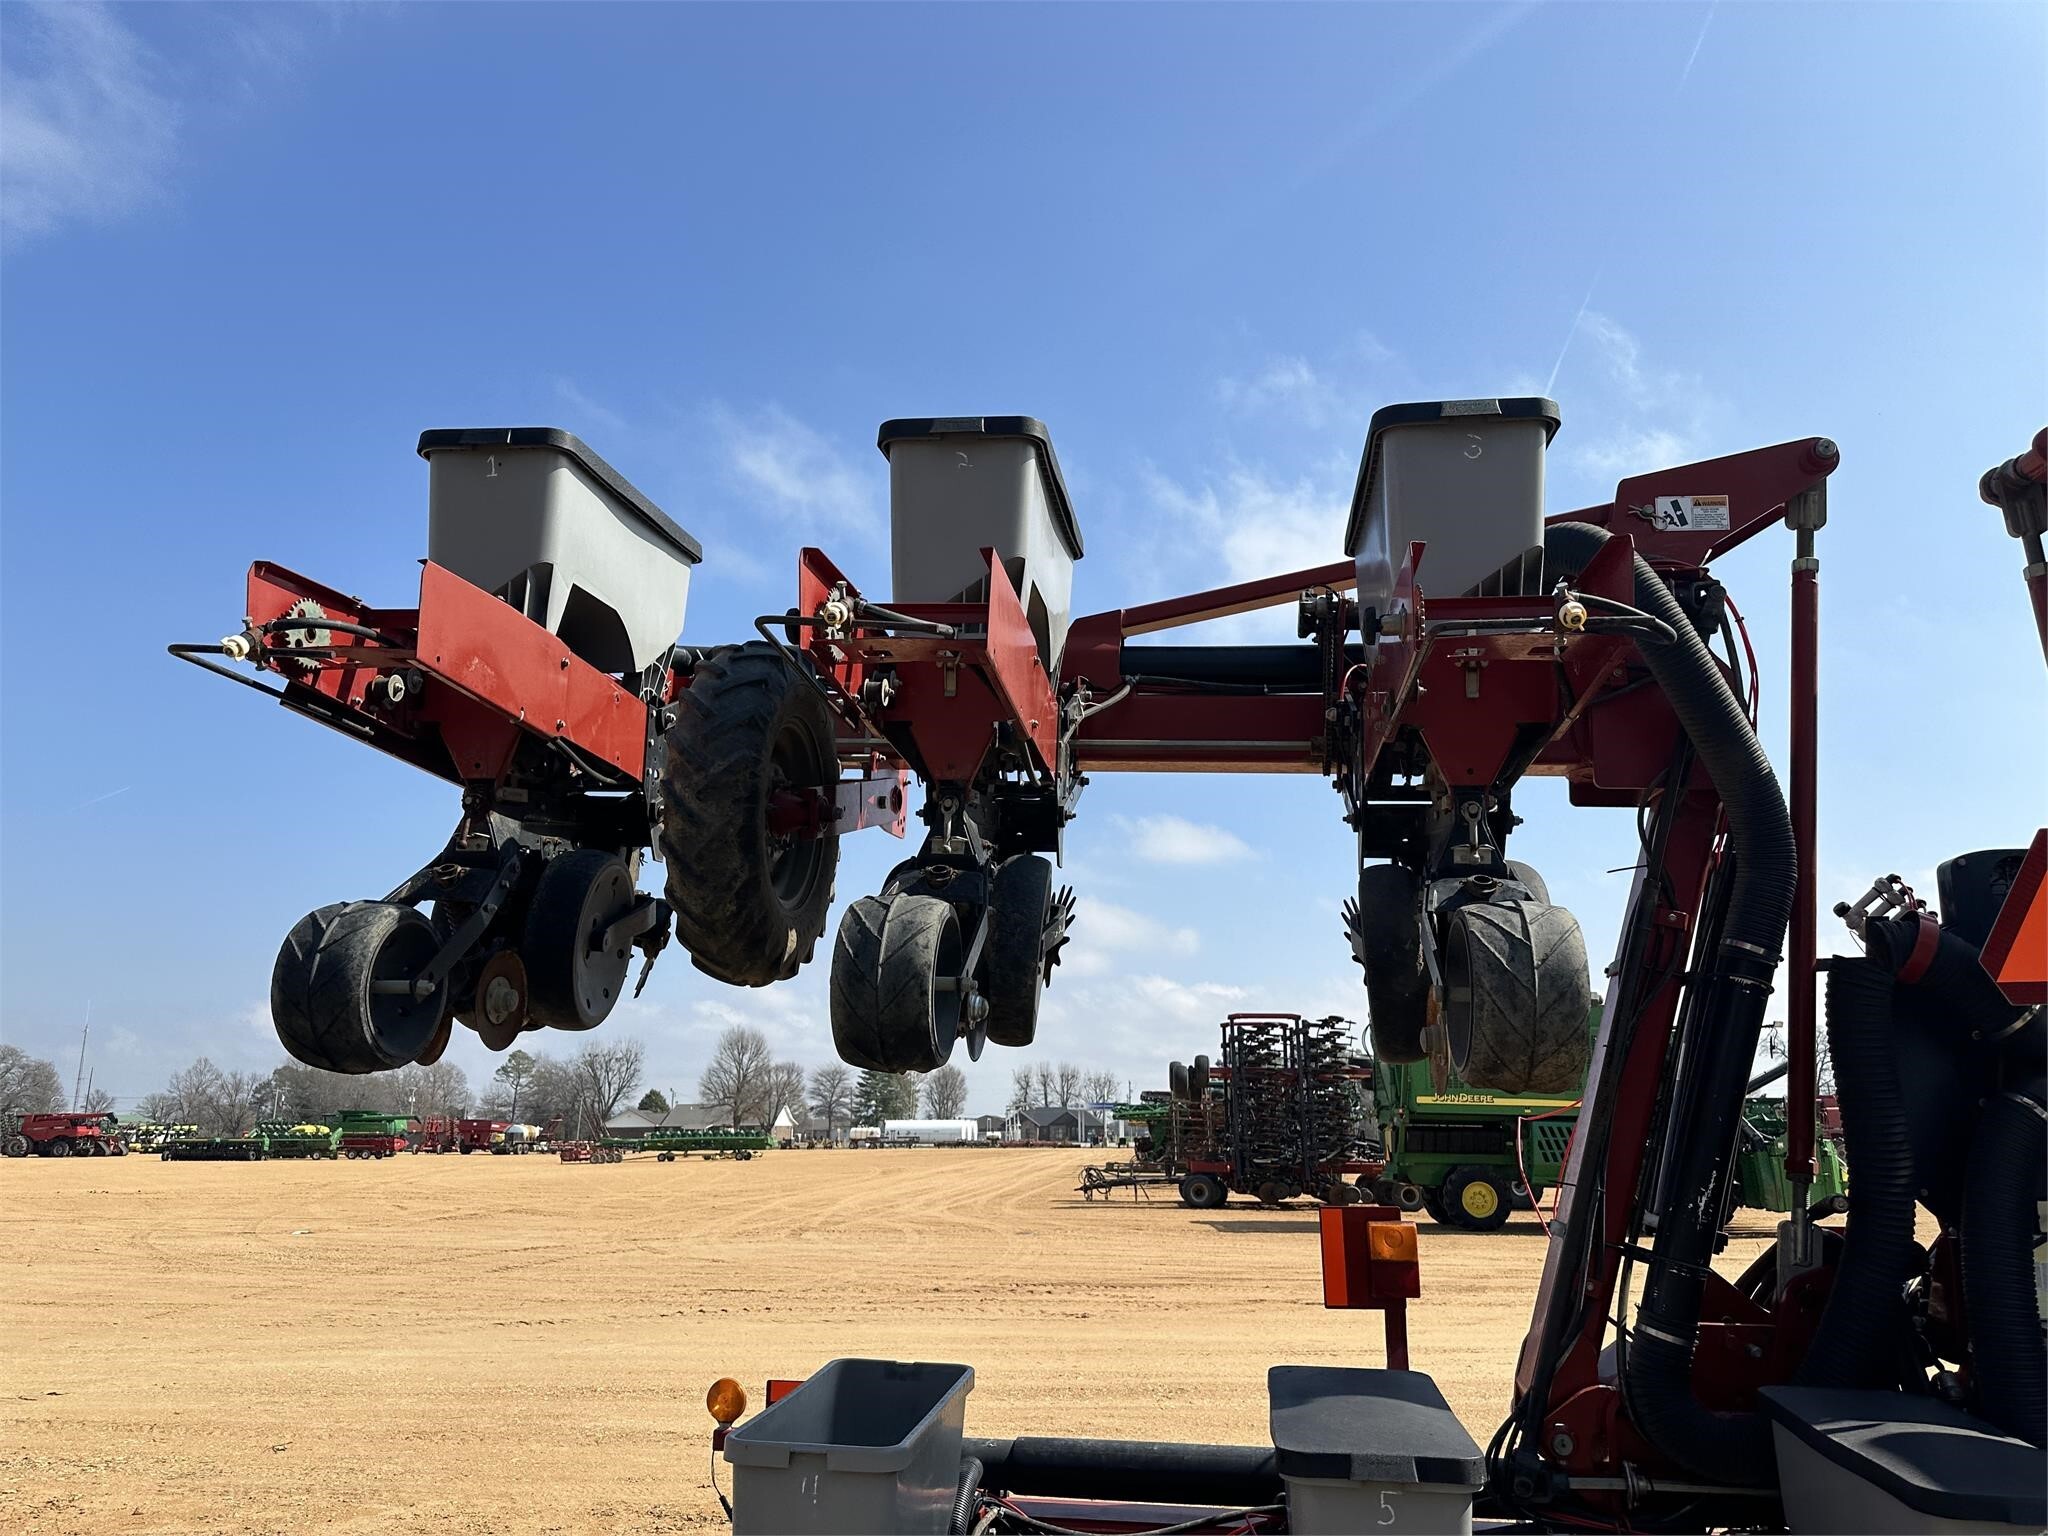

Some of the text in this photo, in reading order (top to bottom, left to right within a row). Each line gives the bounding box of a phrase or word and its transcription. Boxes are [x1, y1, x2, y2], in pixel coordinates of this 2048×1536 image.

[1464, 433, 1482, 459] 3
[486, 455, 498, 478] 1
[955, 451, 975, 469] 2
[1432, 1093, 1495, 1103] JOHN DEERE
[1377, 1490, 1401, 1525] 5
